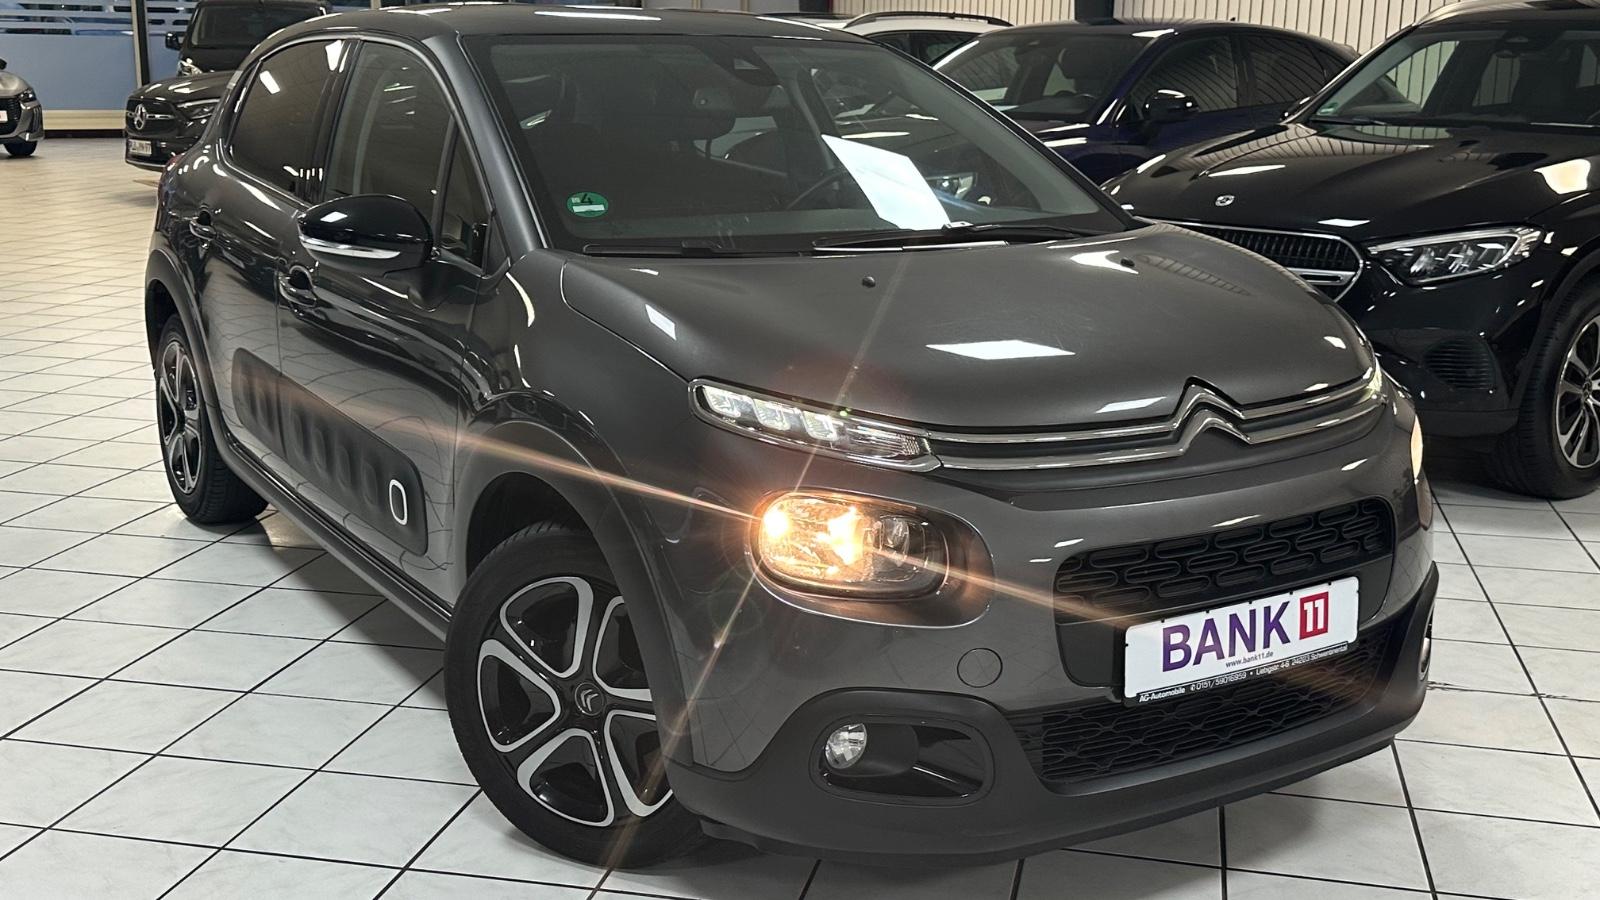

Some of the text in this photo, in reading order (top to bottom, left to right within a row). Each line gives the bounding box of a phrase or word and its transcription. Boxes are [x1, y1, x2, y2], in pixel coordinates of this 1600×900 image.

[580, 193, 594, 205] 4
[1162, 597, 1326, 673] BANK 11
[1225, 651, 1274, 668] www.bank11.de
[1138, 687, 1186, 703] AG-Automobile
